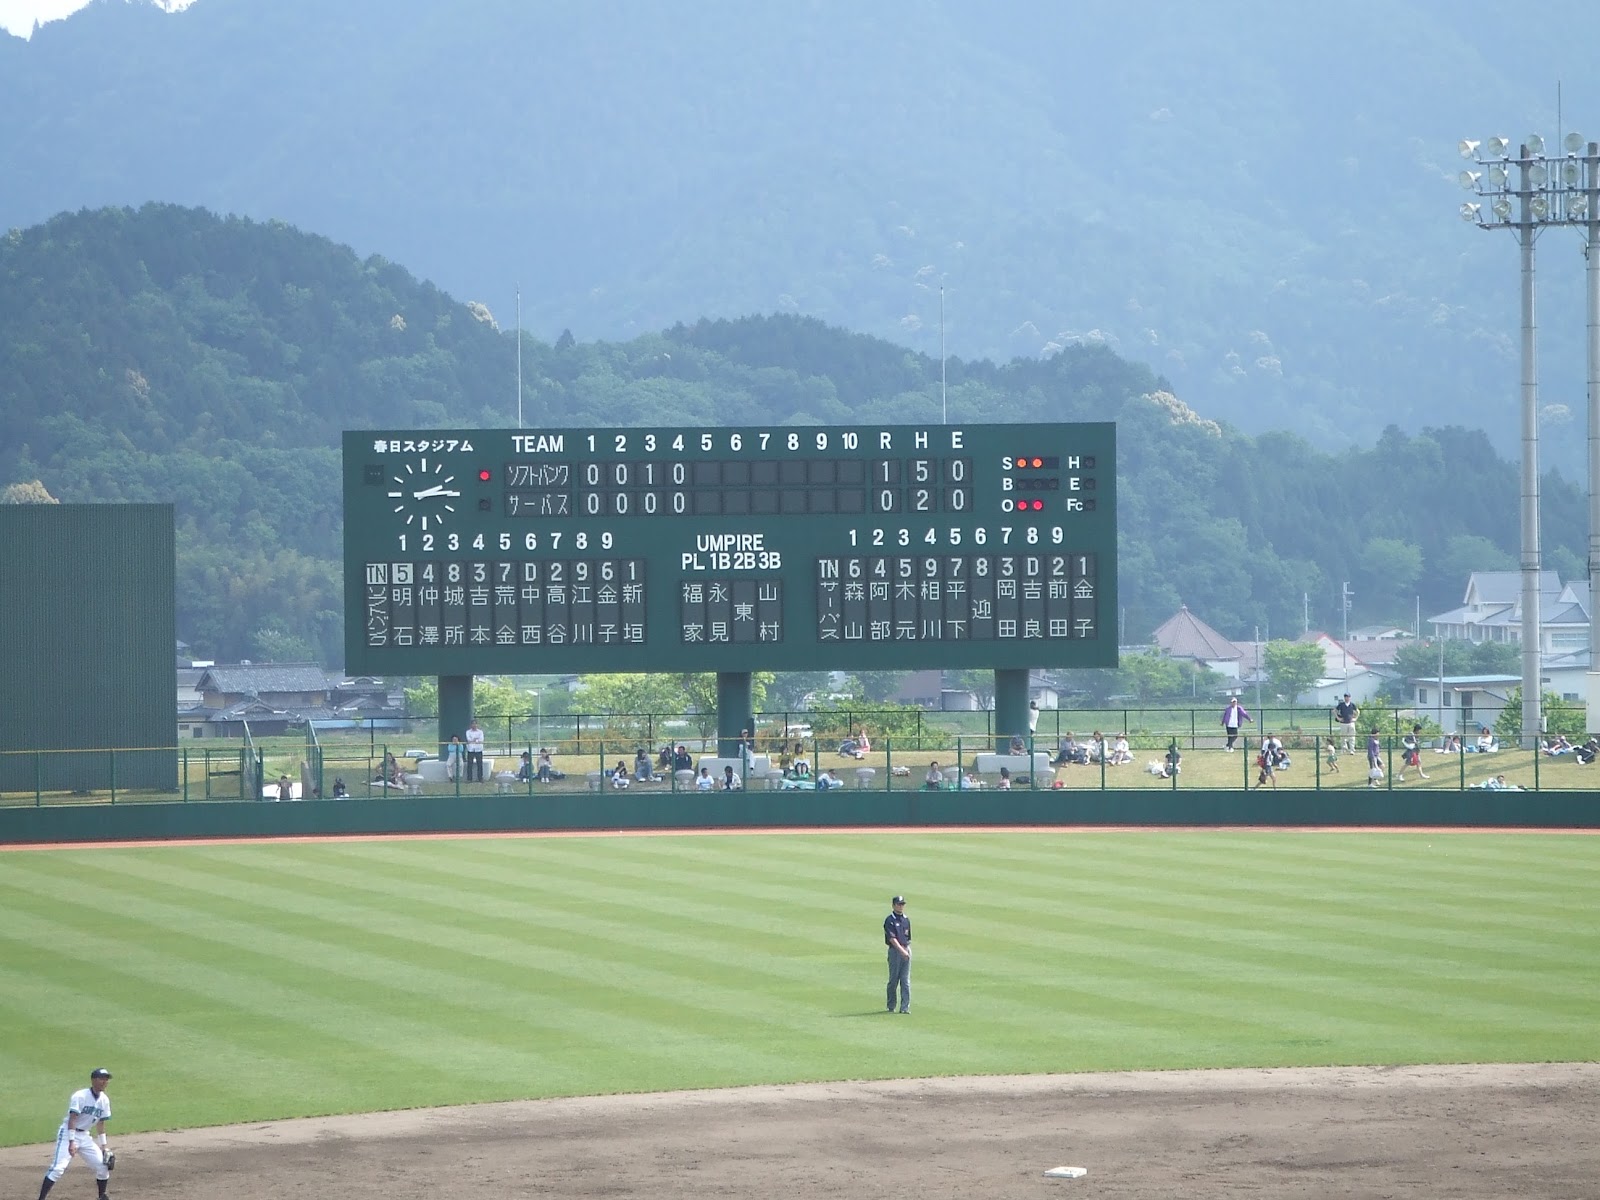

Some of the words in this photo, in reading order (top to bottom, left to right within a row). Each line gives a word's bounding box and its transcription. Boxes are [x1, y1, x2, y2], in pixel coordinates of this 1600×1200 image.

[374, 440, 473, 452] 春日スタジアム
[512, 435, 563, 452] TEAM
[588, 435, 594, 451] 1
[615, 435, 626, 452] 2
[645, 435, 656, 451] 3
[673, 435, 684, 451] 4
[702, 434, 712, 451] 5
[731, 434, 741, 451] 6
[760, 434, 770, 450] 7
[788, 433, 799, 450] 8
[817, 433, 827, 450] 9
[842, 433, 857, 449] 10
[881, 432, 891, 449] R
[916, 432, 927, 448] H
[952, 432, 963, 448] E
[1003, 457, 1012, 470] S
[1069, 456, 1079, 468] H
[509, 465, 568, 485] ソフトバンク
[588, 464, 598, 484] 0
[616, 464, 627, 484] 0
[646, 464, 652, 484] 1
[674, 464, 684, 484] 0
[883, 461, 888, 481] 1
[917, 461, 927, 481] 5
[953, 461, 963, 481] 0
[1003, 478, 1013, 490] B
[1070, 478, 1080, 490] E
[510, 494, 567, 515] サーパス
[588, 493, 599, 514] 0
[617, 493, 627, 513] 0
[645, 493, 656, 513] 0
[674, 493, 684, 513] 0
[881, 490, 892, 510] 0
[917, 490, 928, 510] 2
[953, 490, 963, 510] 0
[399, 535, 405, 551] 1
[423, 534, 433, 551] 2
[448, 534, 459, 550] 3
[473, 534, 484, 550] 4
[500, 534, 510, 550] 5
[526, 533, 536, 550] 6
[551, 533, 561, 549] 7
[577, 533, 587, 549] 8
[602, 532, 612, 549] 9
[682, 554, 705, 570] PL
[711, 554, 730, 569] 1B
[734, 553, 755, 569] 2B
[758, 552, 781, 569] 3B
[697, 534, 764, 551] UMPIRE
[850, 530, 856, 546] 1
[873, 529, 883, 545] 2
[899, 529, 909, 545] 3
[925, 528, 936, 544] 4
[950, 528, 961, 544] 5
[975, 528, 986, 544] 6
[1002, 528, 1012, 544] 7
[1027, 527, 1038, 544] 8
[1052, 527, 1063, 543] 9
[367, 565, 386, 583] TN
[398, 564, 408, 582] 5
[423, 564, 434, 582] 4
[449, 564, 459, 582] 8
[474, 564, 485, 581] 3
[500, 563, 510, 581] 7
[526, 563, 536, 581] D
[551, 563, 562, 581] 2
[577, 563, 587, 580] 9
[602, 562, 613, 580] 6
[629, 562, 635, 580] 1
[819, 560, 838, 578] TN
[850, 560, 860, 577] 6
[875, 559, 885, 577] 4
[900, 559, 911, 577] 5
[926, 559, 936, 576] 9
[951, 558, 962, 576] 7
[977, 558, 987, 576] 8
[1002, 558, 1013, 576] 3
[1028, 558, 1038, 575] D
[1053, 557, 1064, 575] 2
[1080, 557, 1085, 575] 1
[393, 588, 413, 645] 明石
[419, 586, 439, 645] 仲澤
[444, 586, 464, 644] 城所
[470, 586, 490, 644] 吉本
[495, 585, 515, 644] 荒金
[522, 585, 541, 643] 中西
[547, 585, 566, 643] 高谷
[572, 585, 592, 643] 江川
[598, 584, 617, 642] 金子
[623, 584, 643, 642] 新垣
[683, 584, 703, 642] 福家
[709, 583, 728, 641] 永見
[734, 602, 753, 621] 東
[760, 584, 779, 641] 山村
[820, 582, 840, 639] サーパス
[845, 581, 864, 639] 森山
[870, 582, 890, 639] 阿部
[896, 581, 915, 639] 木元
[921, 581, 941, 639] 相川
[947, 581, 966, 638] 平下
[972, 600, 991, 619] 迎
[997, 580, 1016, 637] 岡田
[1023, 580, 1042, 638] 吉良
[1049, 579, 1067, 636] 前田
[1074, 579, 1093, 637] 金子
